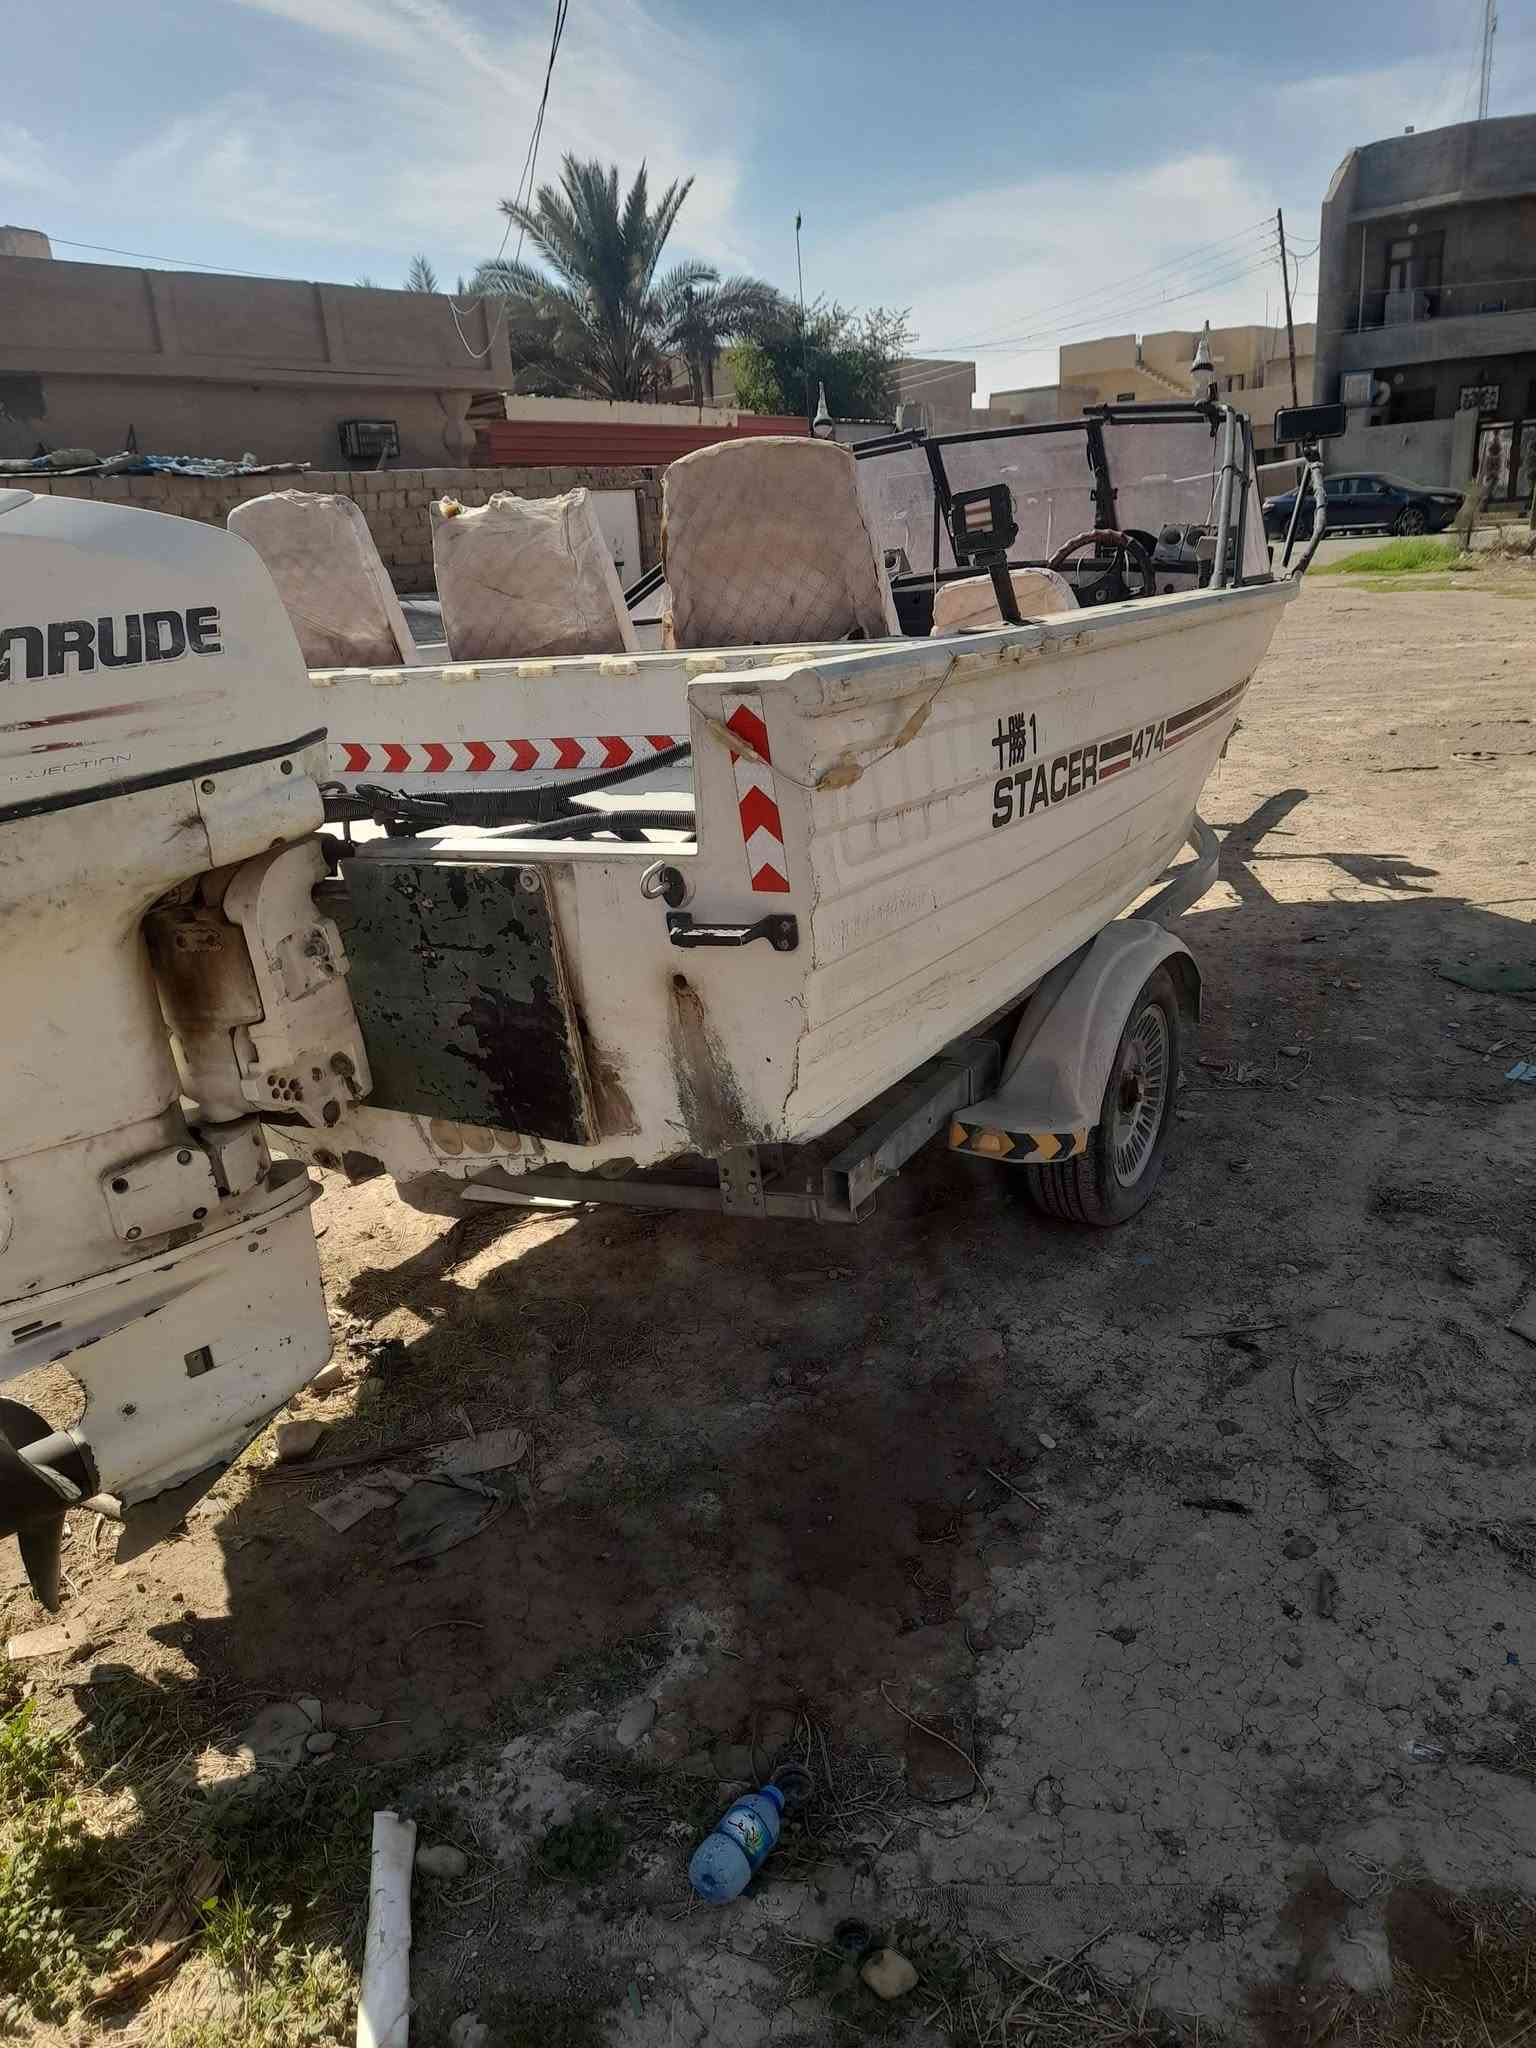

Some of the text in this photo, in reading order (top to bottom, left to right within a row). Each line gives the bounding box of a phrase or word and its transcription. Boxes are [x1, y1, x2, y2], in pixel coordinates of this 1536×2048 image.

[9, 752, 132, 783] JECTION
[992, 721, 1165, 828] STACER 474
